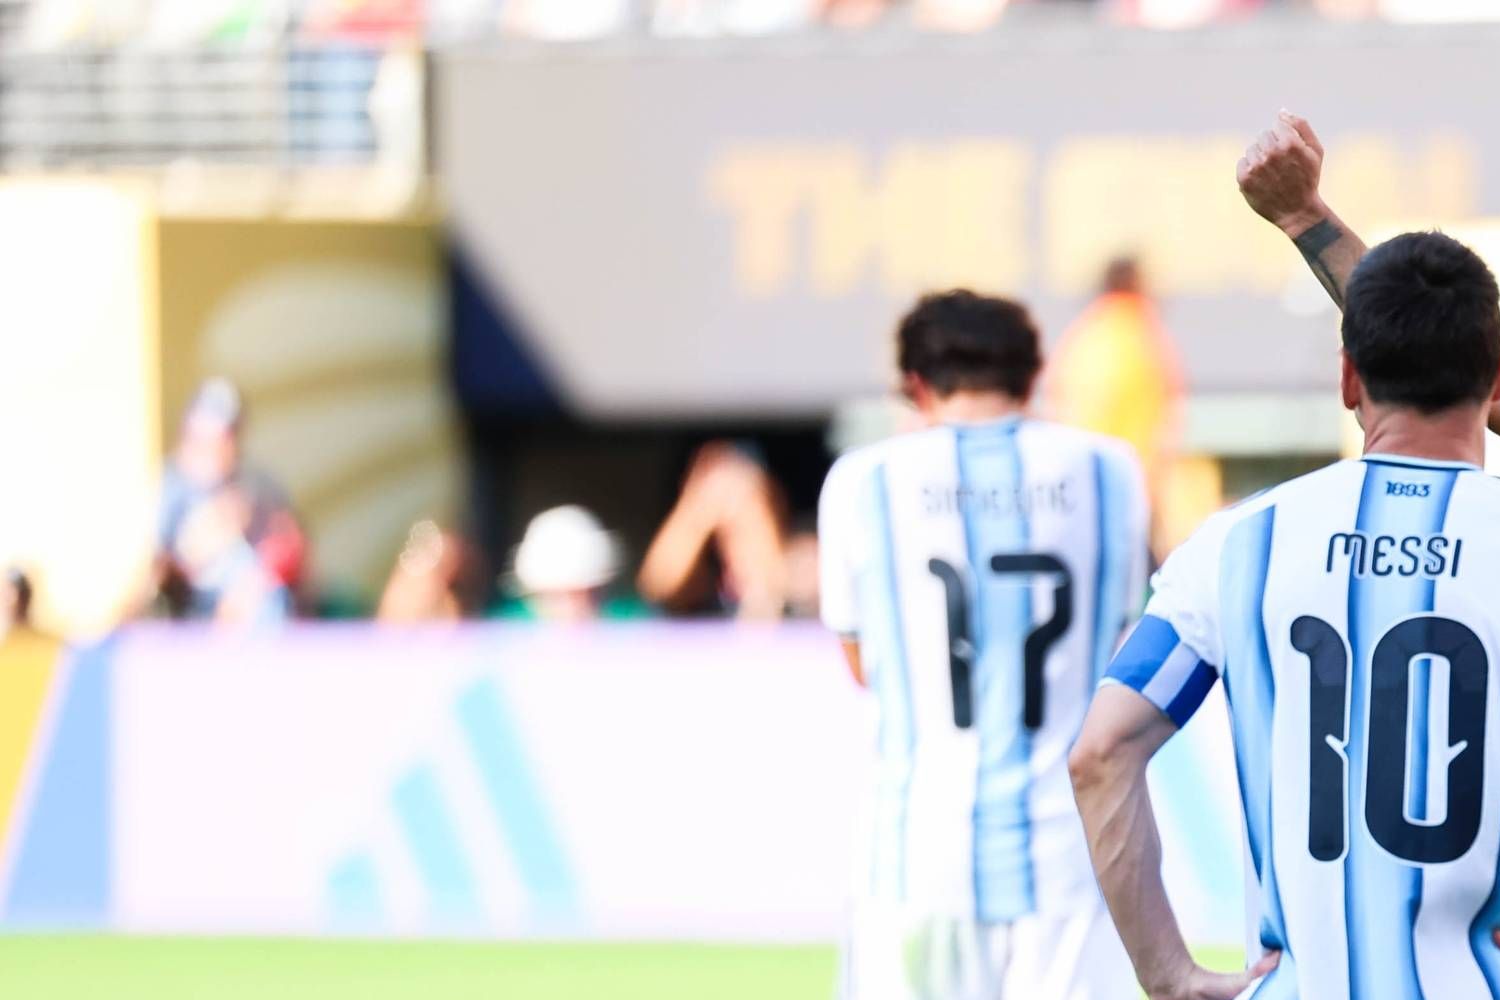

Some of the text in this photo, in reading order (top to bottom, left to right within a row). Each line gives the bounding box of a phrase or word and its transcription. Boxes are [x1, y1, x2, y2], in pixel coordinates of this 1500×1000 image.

[1385, 480, 1431, 497] 1893
[1326, 532, 1463, 578] MESSI
[928, 554, 1074, 729] 17
[1289, 615, 1490, 864] 10
